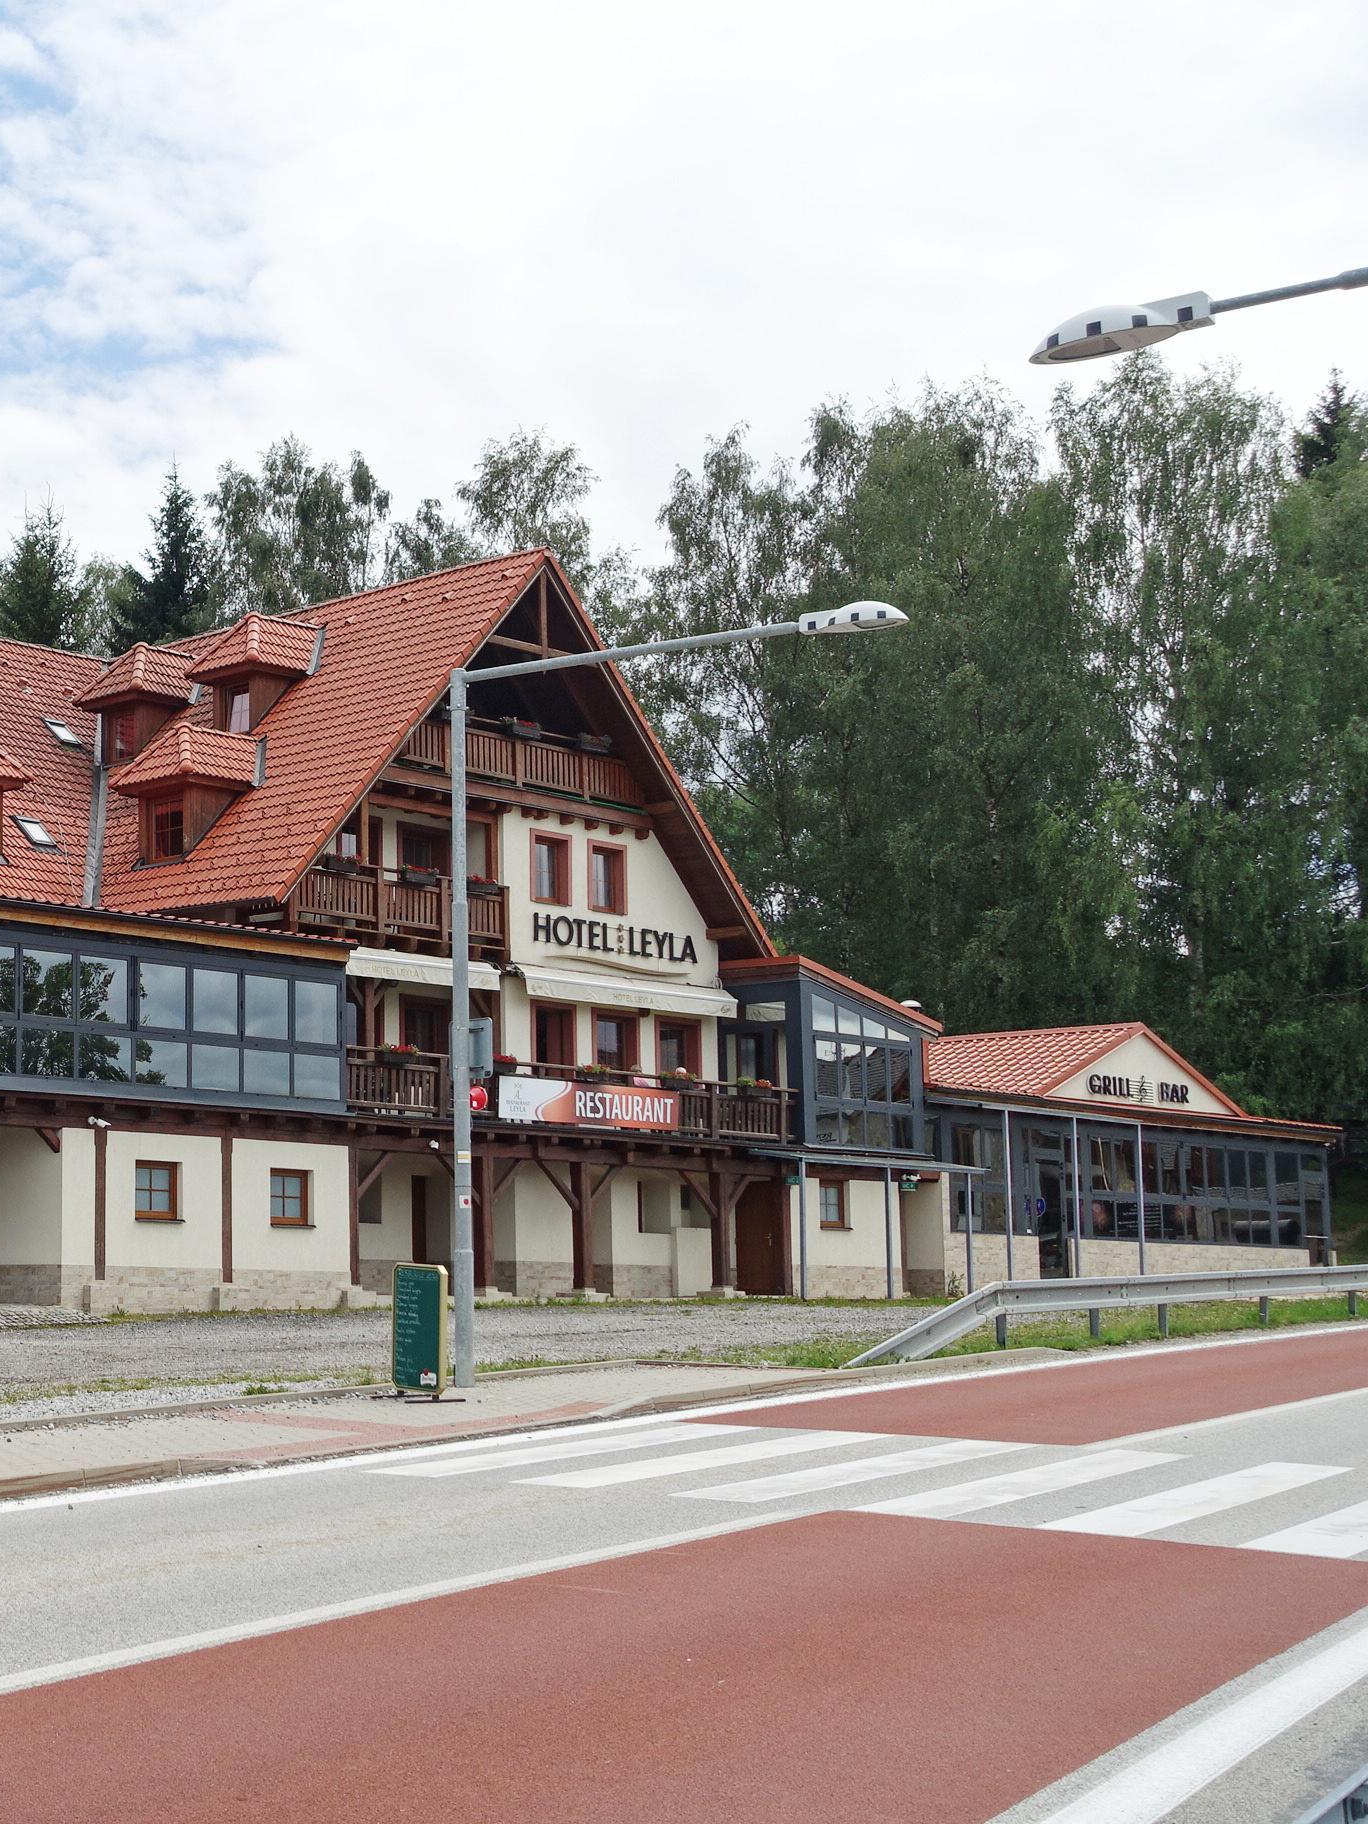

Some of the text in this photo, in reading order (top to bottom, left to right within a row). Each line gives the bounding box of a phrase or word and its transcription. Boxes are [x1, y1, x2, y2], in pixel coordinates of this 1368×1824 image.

[533, 912, 698, 964] HOTEL LEYLA
[1088, 1073, 1189, 1104] GRILL BAR
[575, 1090, 674, 1124] RESTAURANT
